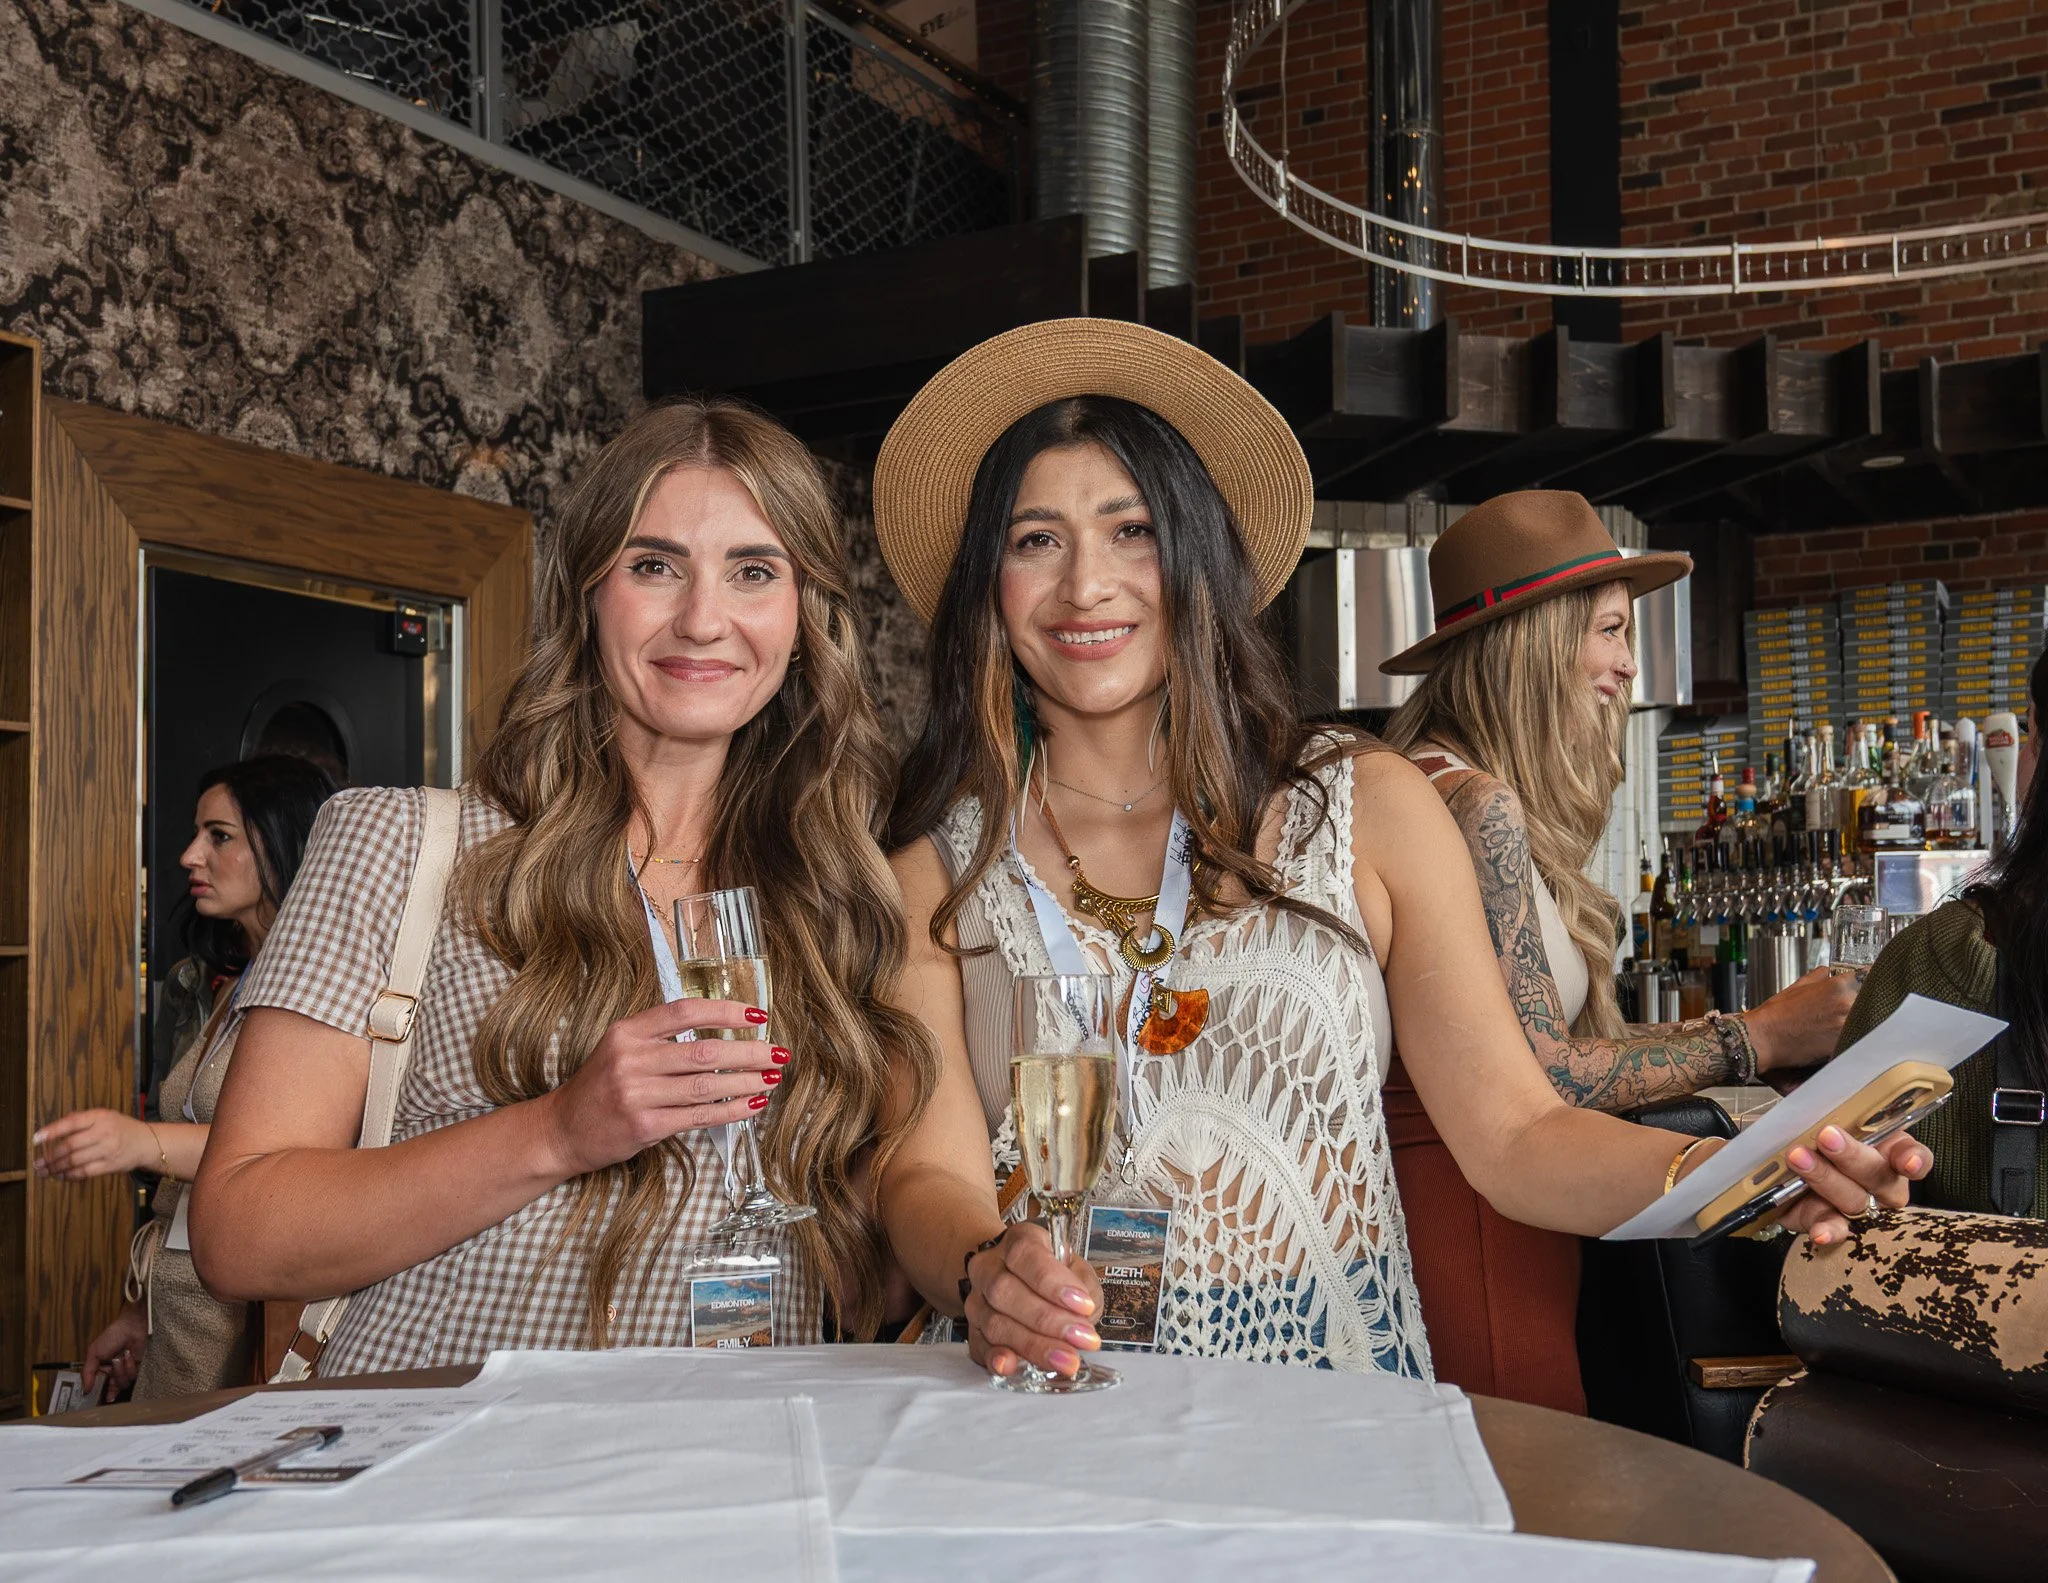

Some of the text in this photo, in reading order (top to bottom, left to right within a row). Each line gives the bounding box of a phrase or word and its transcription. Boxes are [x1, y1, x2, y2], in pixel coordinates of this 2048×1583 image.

[1106, 1229, 1151, 1239] EDMONTON
[1105, 1266, 1143, 1278] LIZETH
[711, 1298, 755, 1309] EDMONTON
[717, 1336, 751, 1348] EMILY
